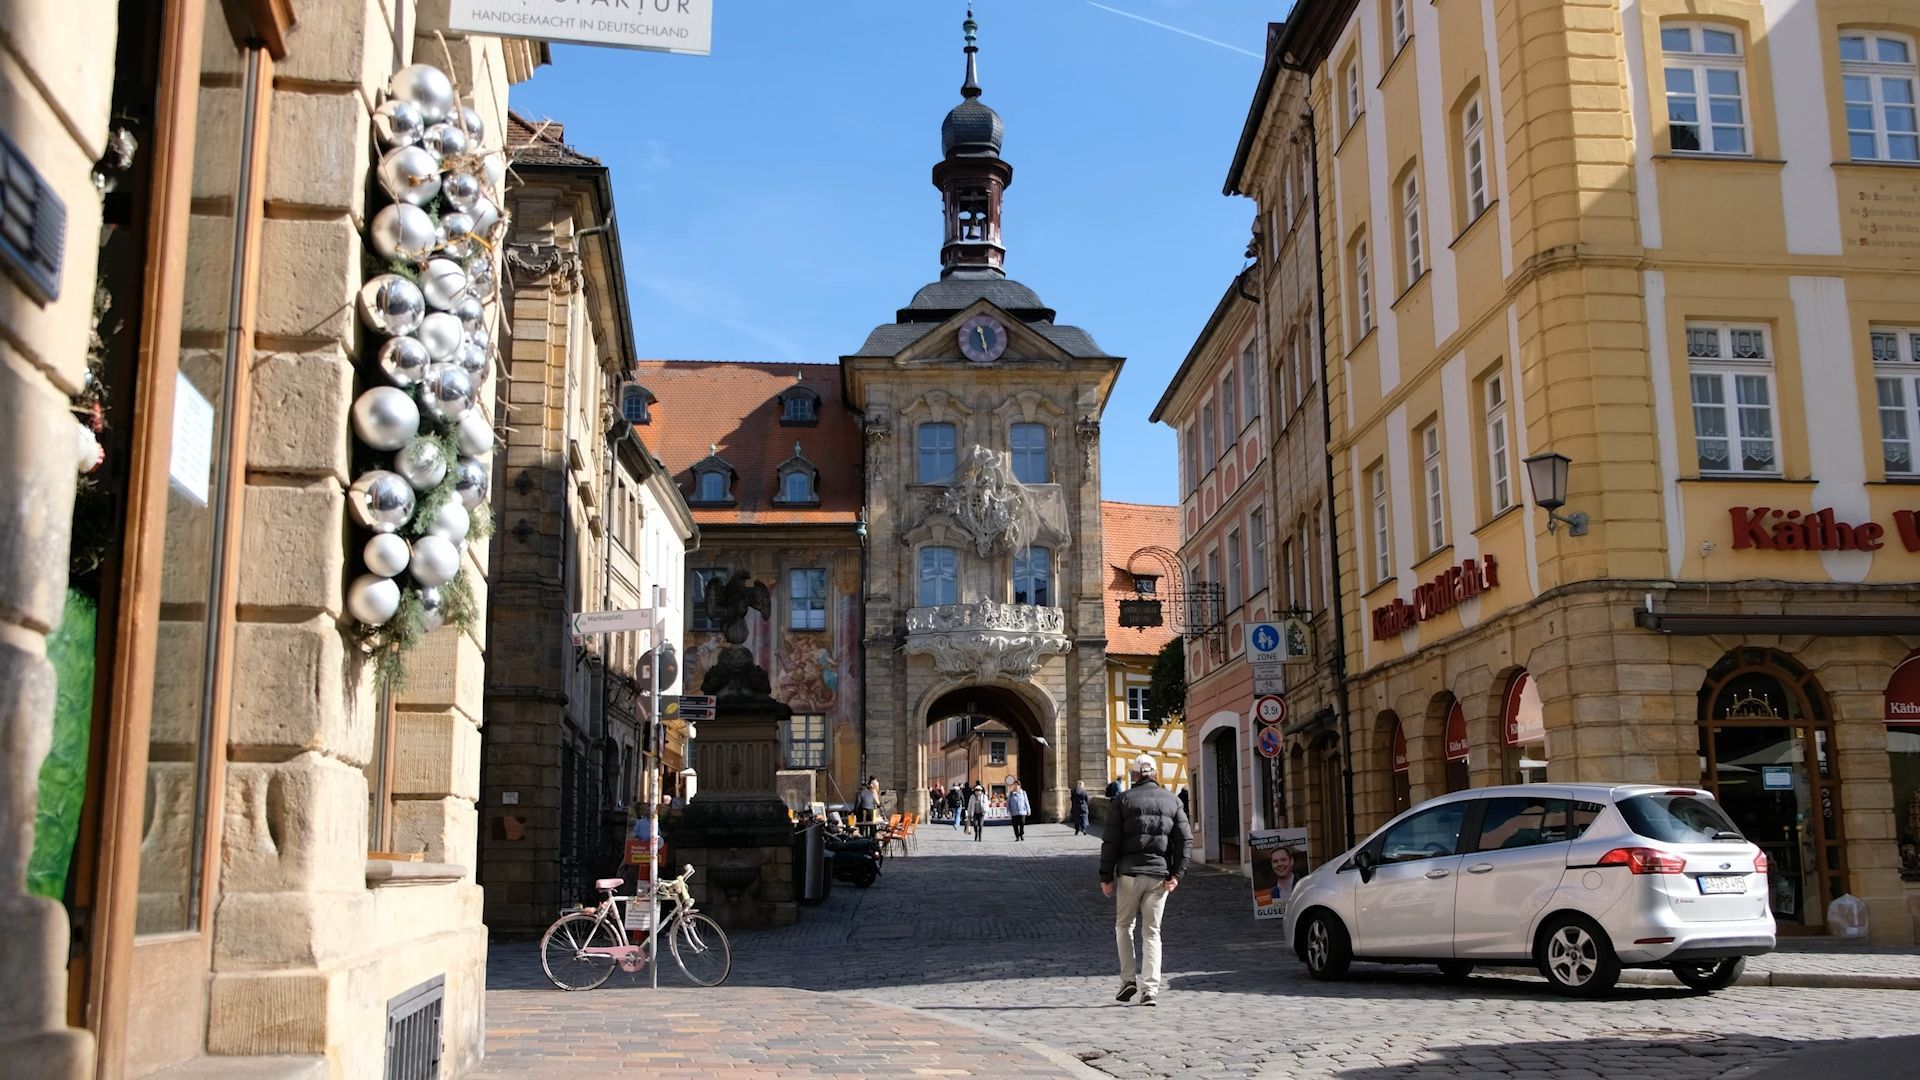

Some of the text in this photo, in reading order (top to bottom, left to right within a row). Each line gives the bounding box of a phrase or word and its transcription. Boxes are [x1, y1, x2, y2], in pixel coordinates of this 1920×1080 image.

[472, 9, 689, 39] HANDGEMACHT IN DEUTSCHLAND
[1728, 506, 1885, 552] Käthe
[587, 614, 624, 623] Markusplatz
[1256, 653, 1278, 661] ZONE
[1263, 705, 1278, 715] 3,5t
